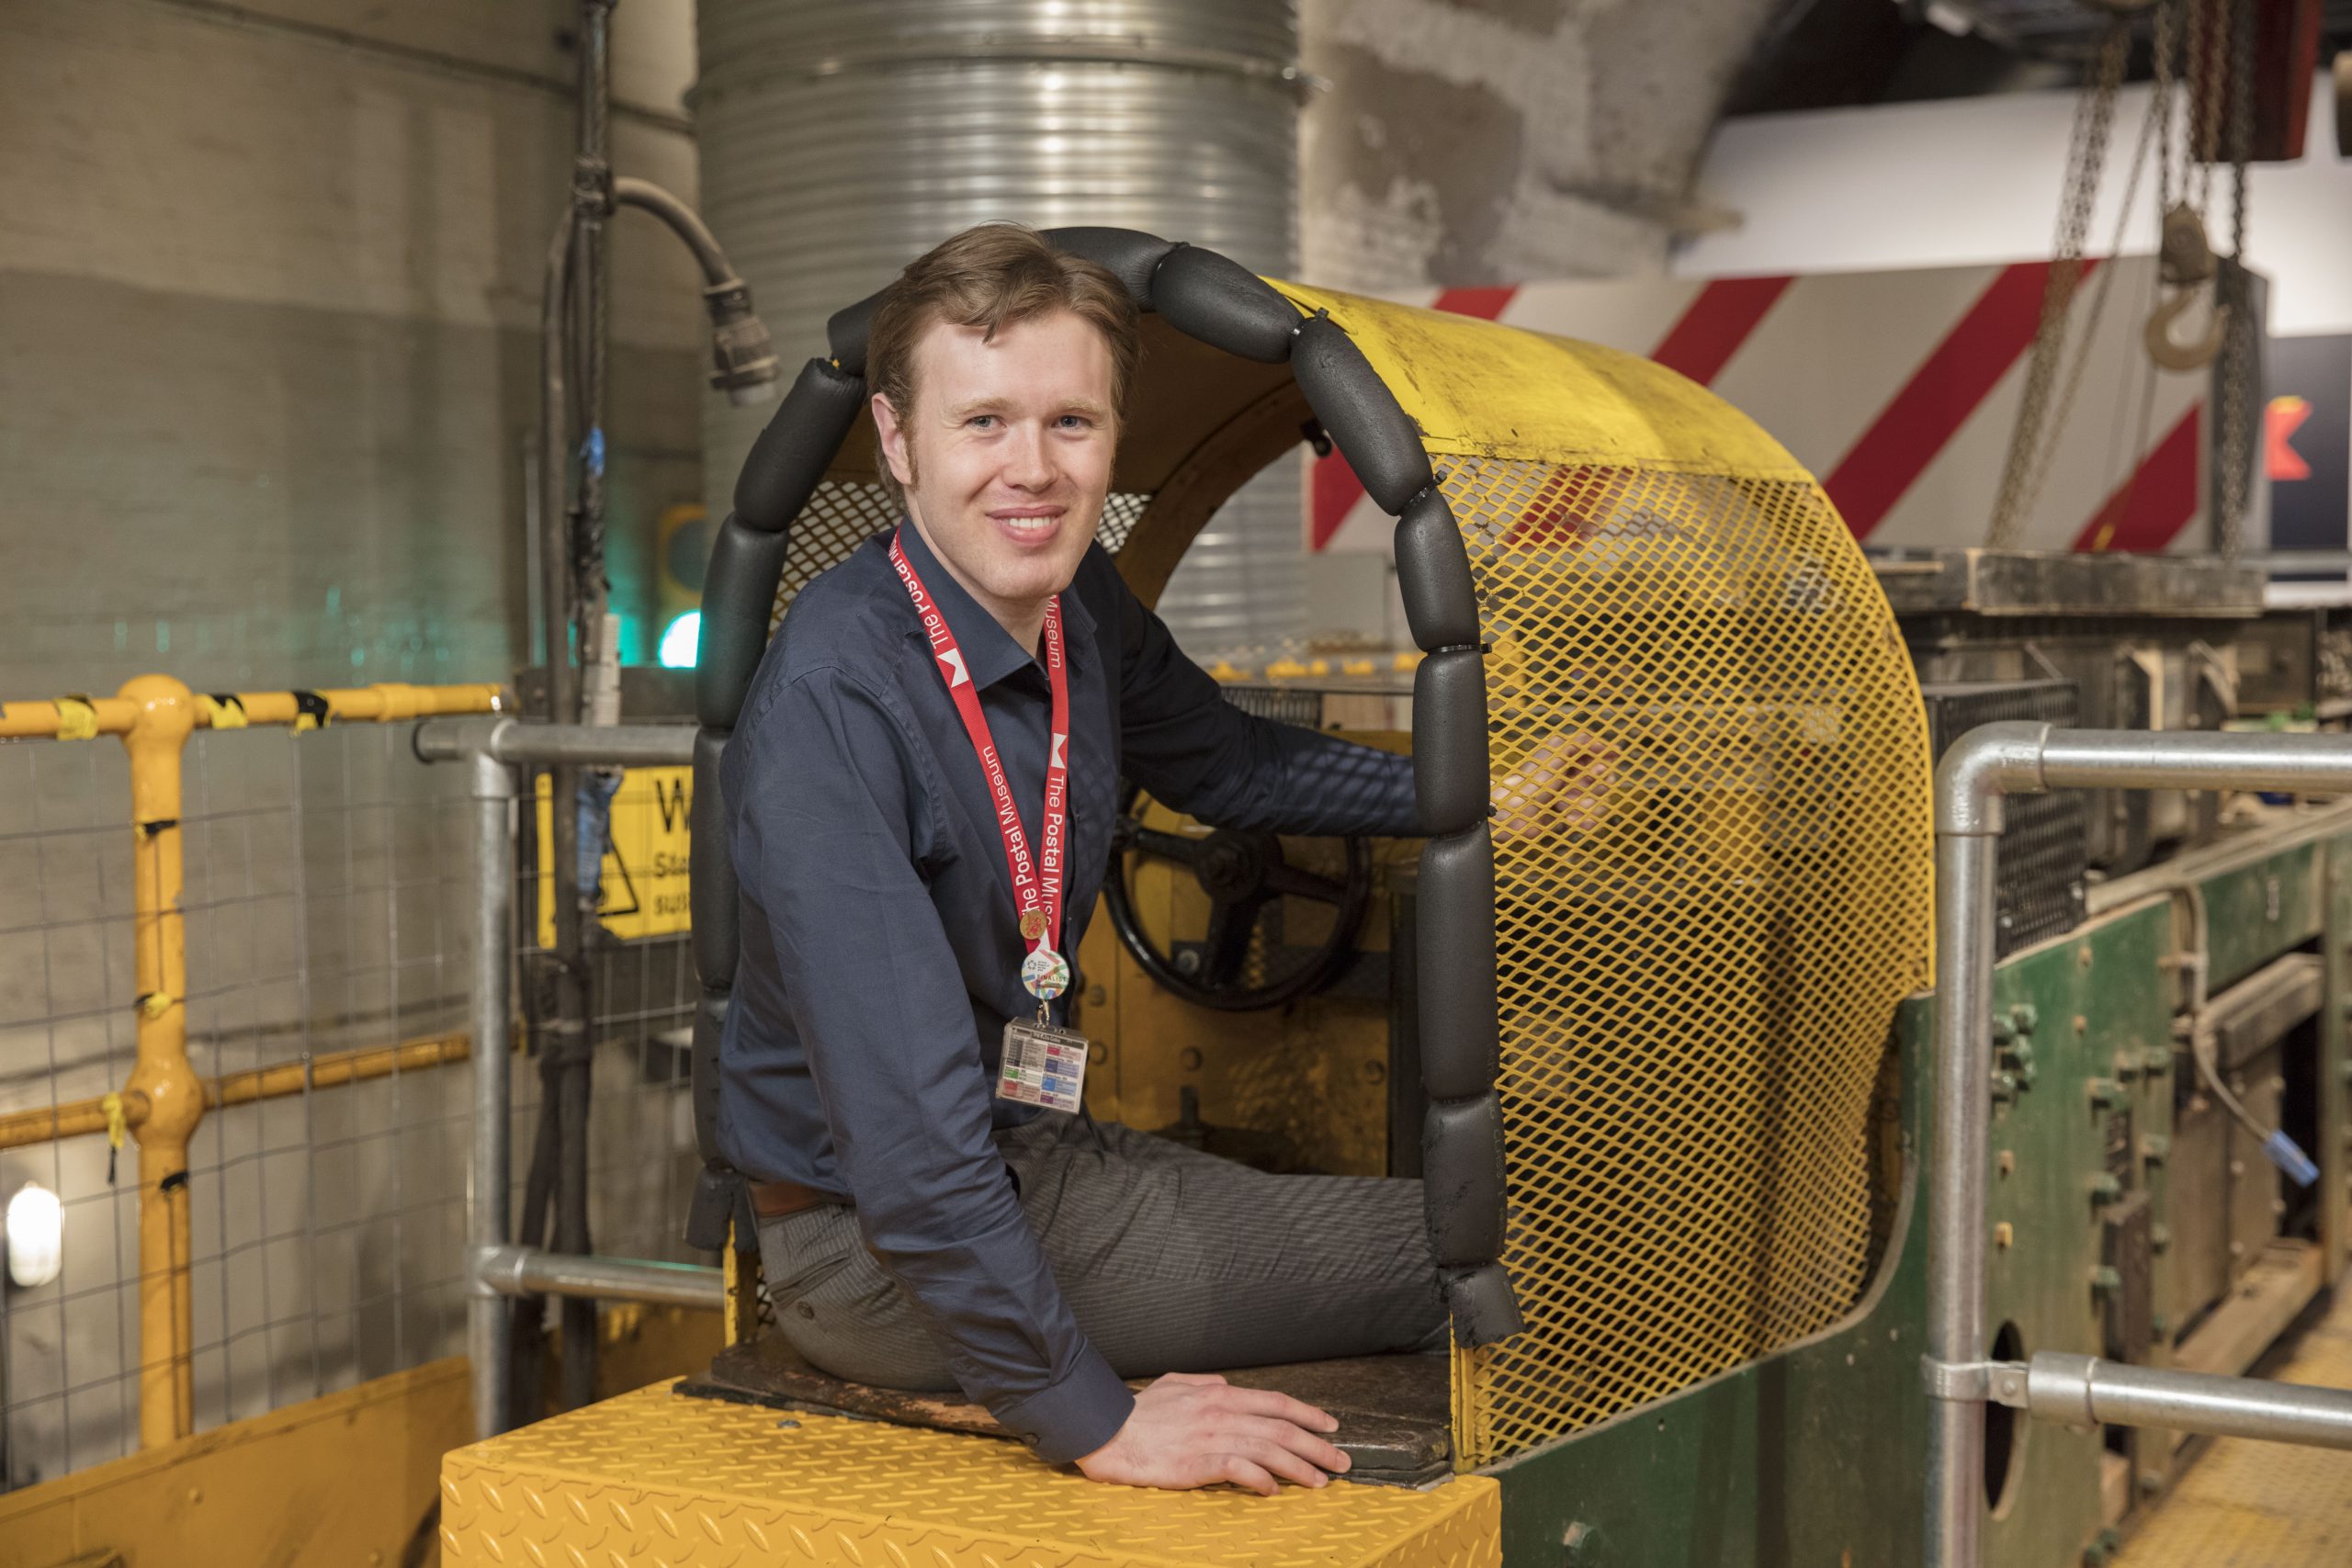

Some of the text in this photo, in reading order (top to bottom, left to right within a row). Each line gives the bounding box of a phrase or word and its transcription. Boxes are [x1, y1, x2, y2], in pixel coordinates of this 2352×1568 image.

[923, 614, 949, 649] The
[983, 745, 1016, 826] Museum
[1048, 775, 1065, 808] The
[1004, 825, 1034, 886] Postal
[1044, 813, 1063, 873] Postal
[1036, 974, 1067, 983] FINALIST
